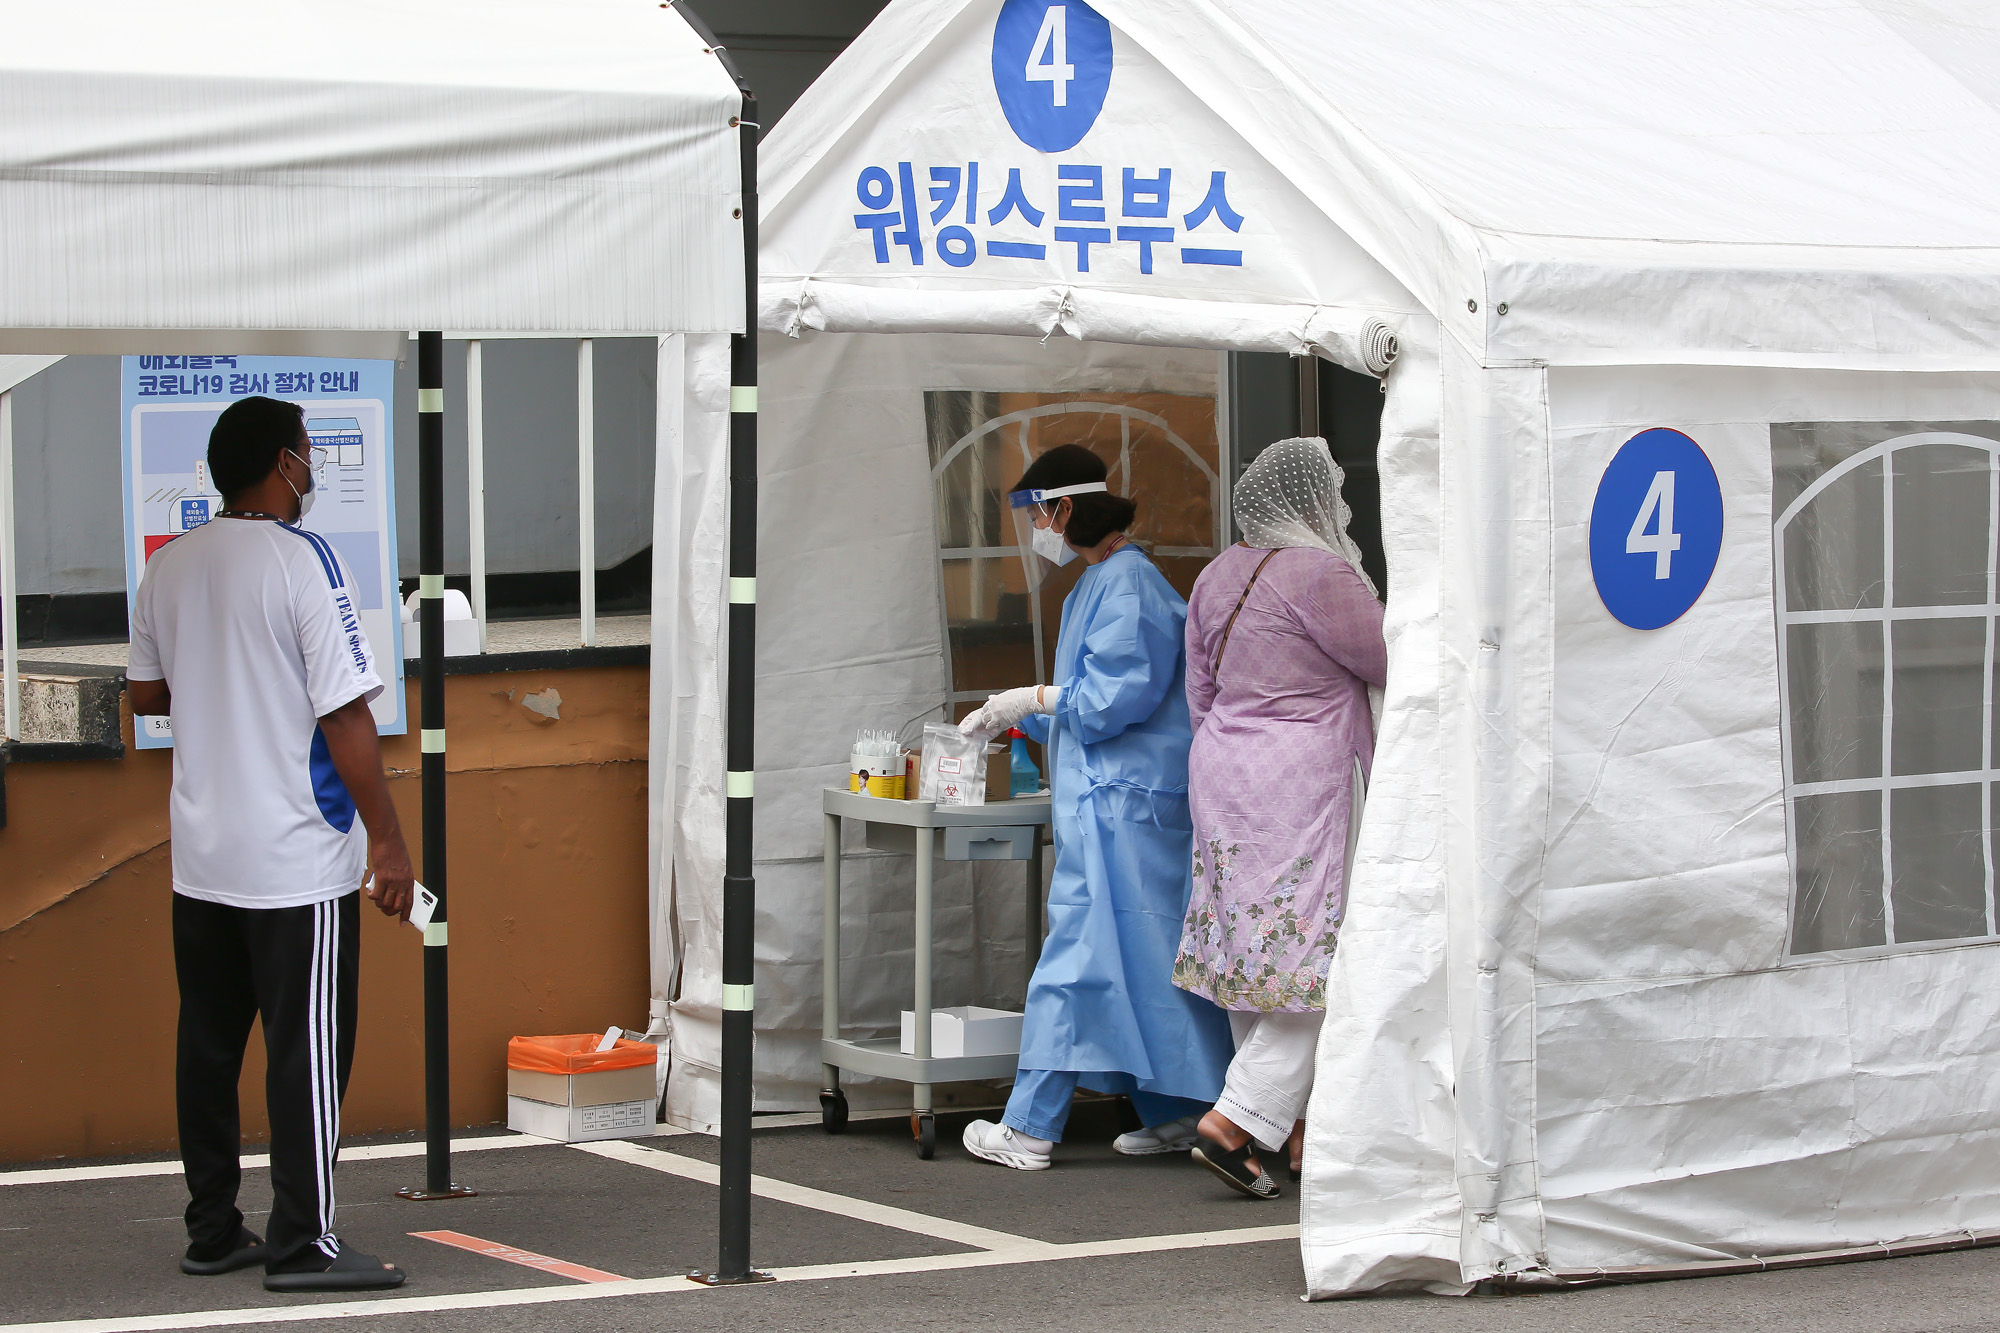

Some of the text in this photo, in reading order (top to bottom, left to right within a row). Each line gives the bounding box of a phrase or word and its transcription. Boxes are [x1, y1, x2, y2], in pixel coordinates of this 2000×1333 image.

[1025, 5, 1075, 107] 4
[853, 161, 1245, 275] 워킹스루부스
[138, 370, 359, 396] 코로나19 검사 절차 안내
[1625, 470, 1681, 580] 4
[335, 592, 359, 634] TEAM
[348, 634, 368, 674] SPORTS
